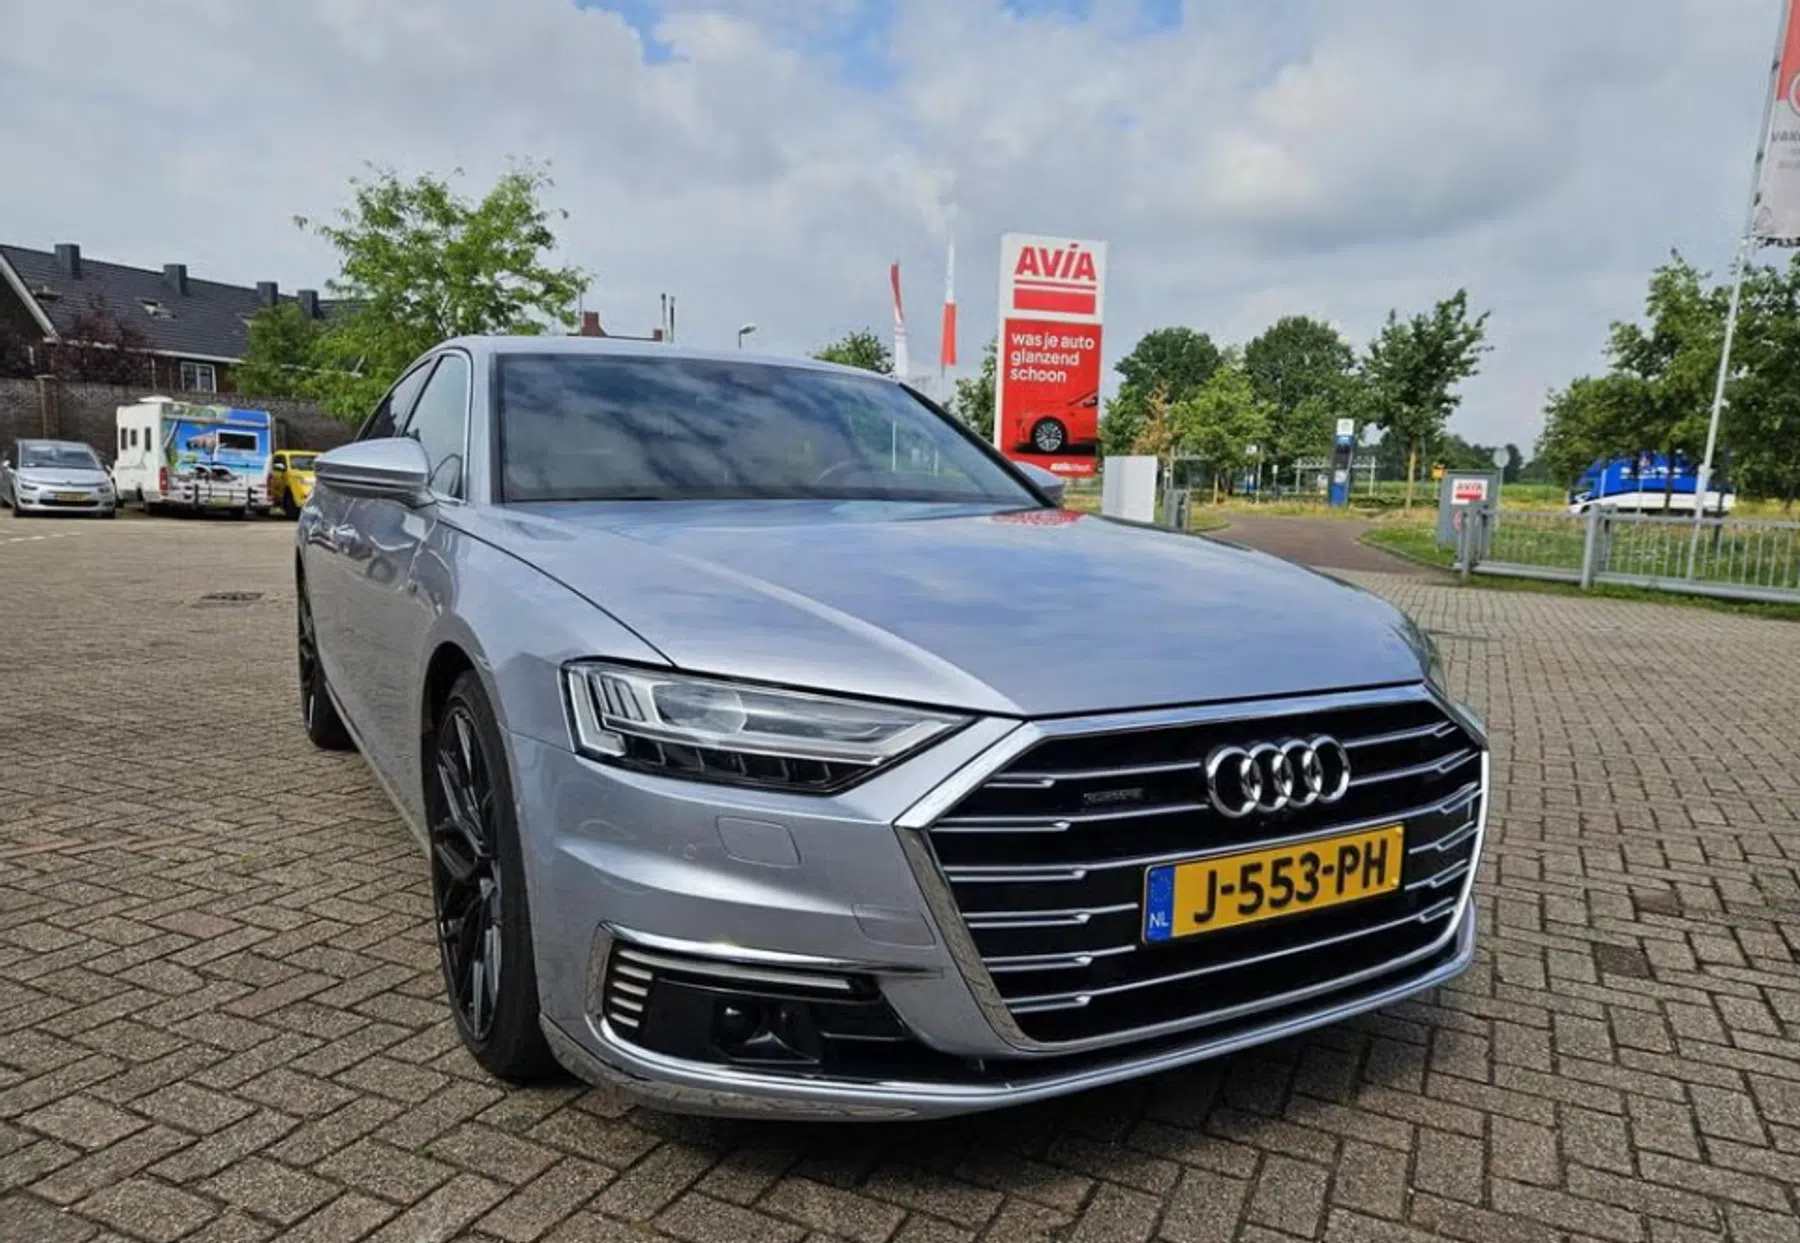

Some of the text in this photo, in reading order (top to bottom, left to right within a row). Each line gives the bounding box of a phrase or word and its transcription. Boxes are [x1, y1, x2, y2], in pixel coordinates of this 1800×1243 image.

[1011, 332, 1095, 350] was je auto
[1010, 348, 1080, 367] glanzend
[1010, 366, 1067, 383] schoon
[1193, 838, 1388, 924] J-553-PH
[1149, 912, 1169, 928] NL
